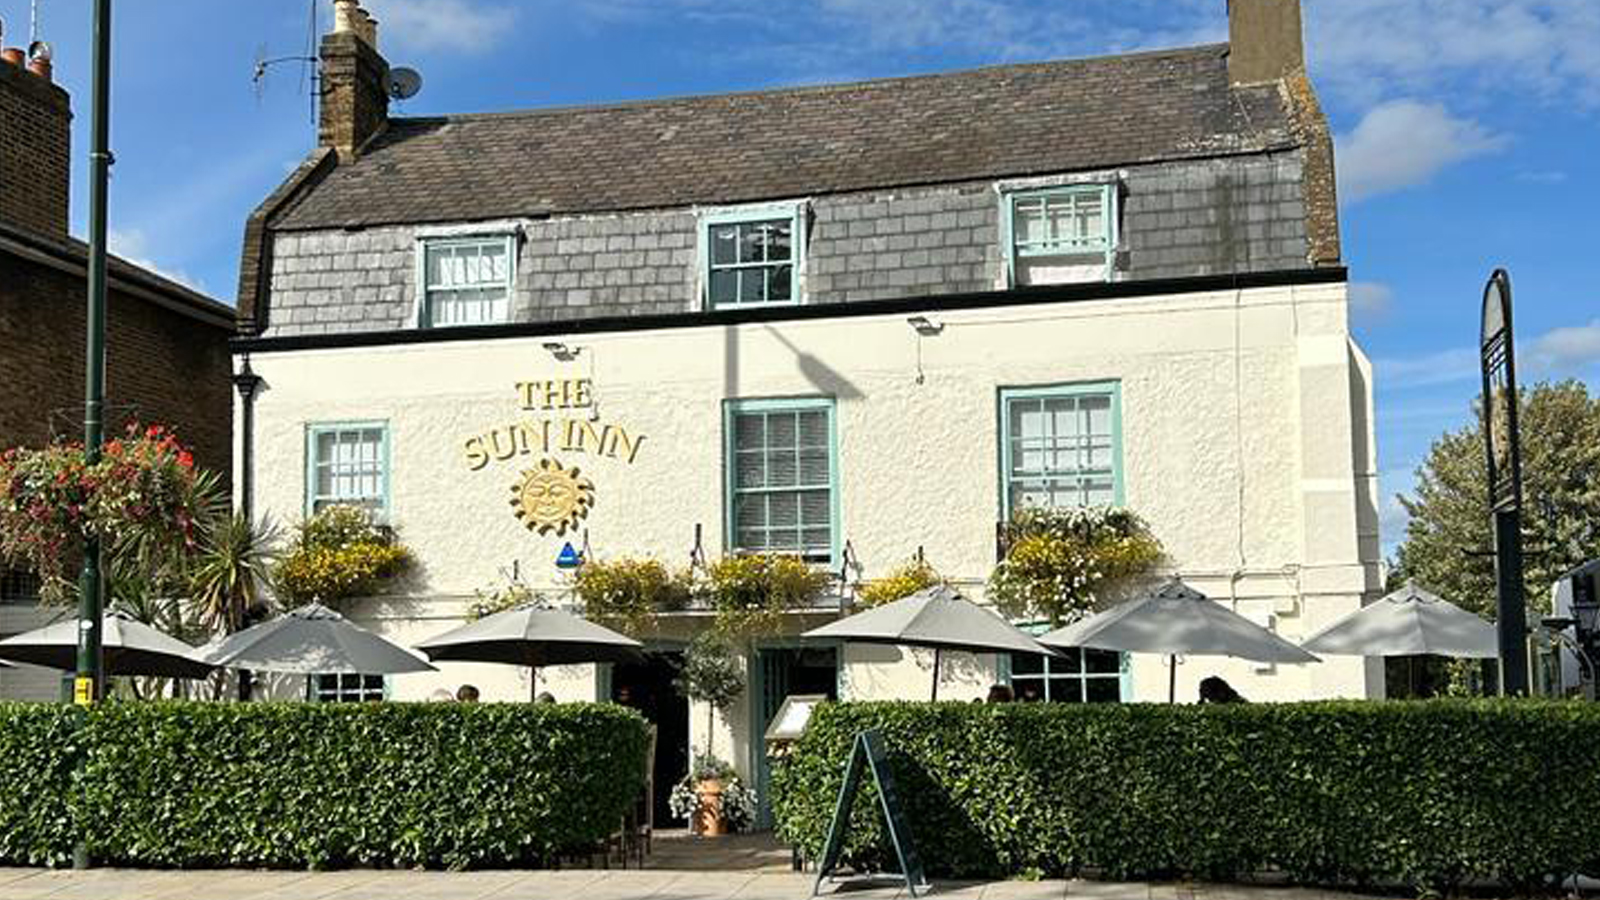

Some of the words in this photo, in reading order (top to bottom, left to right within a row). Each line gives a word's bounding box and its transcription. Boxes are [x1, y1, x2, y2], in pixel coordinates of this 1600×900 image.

[514, 378, 593, 410] THE
[463, 421, 552, 471] SUN
[560, 419, 647, 464] INN
